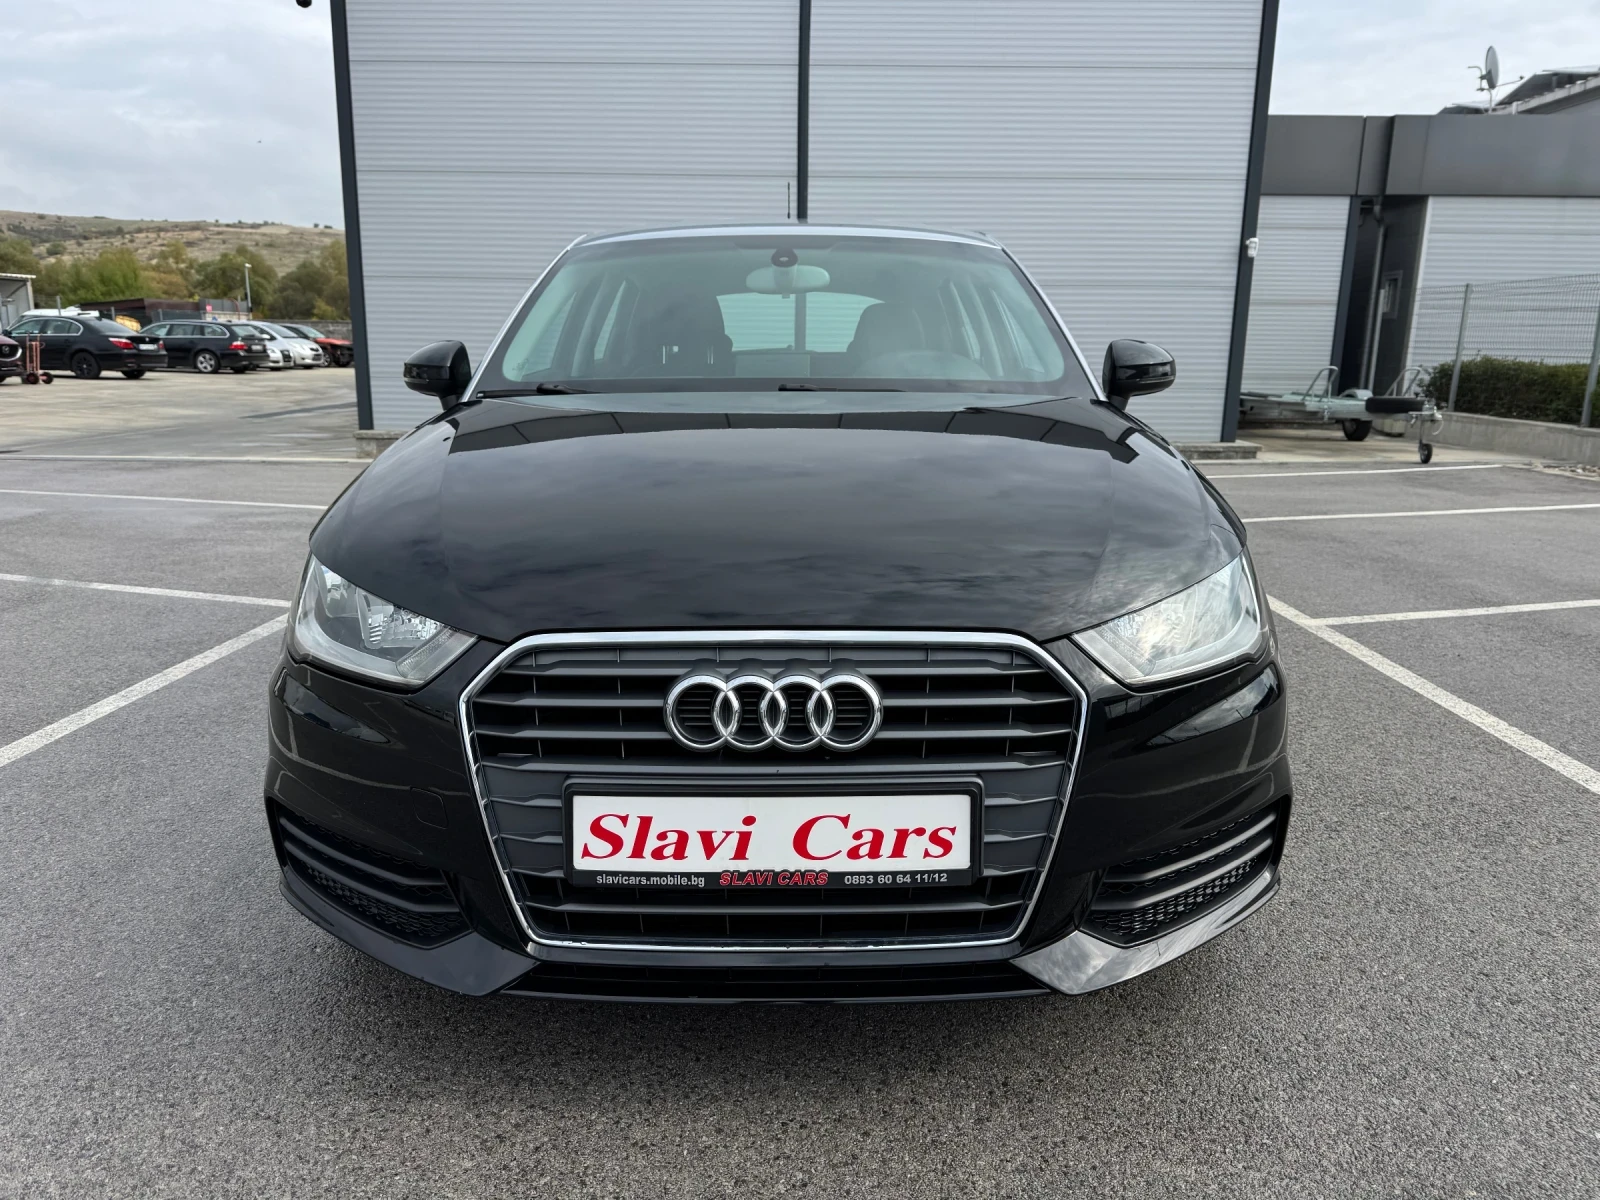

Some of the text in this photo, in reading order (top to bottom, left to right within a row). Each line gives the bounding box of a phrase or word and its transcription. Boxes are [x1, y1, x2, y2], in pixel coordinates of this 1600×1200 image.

[581, 813, 957, 861] Slavi Cars
[596, 873, 705, 887] slavicars.mobile.bg
[719, 872, 829, 886] SLAVI CARS
[844, 873, 948, 885] 0893 60 64 11/12
